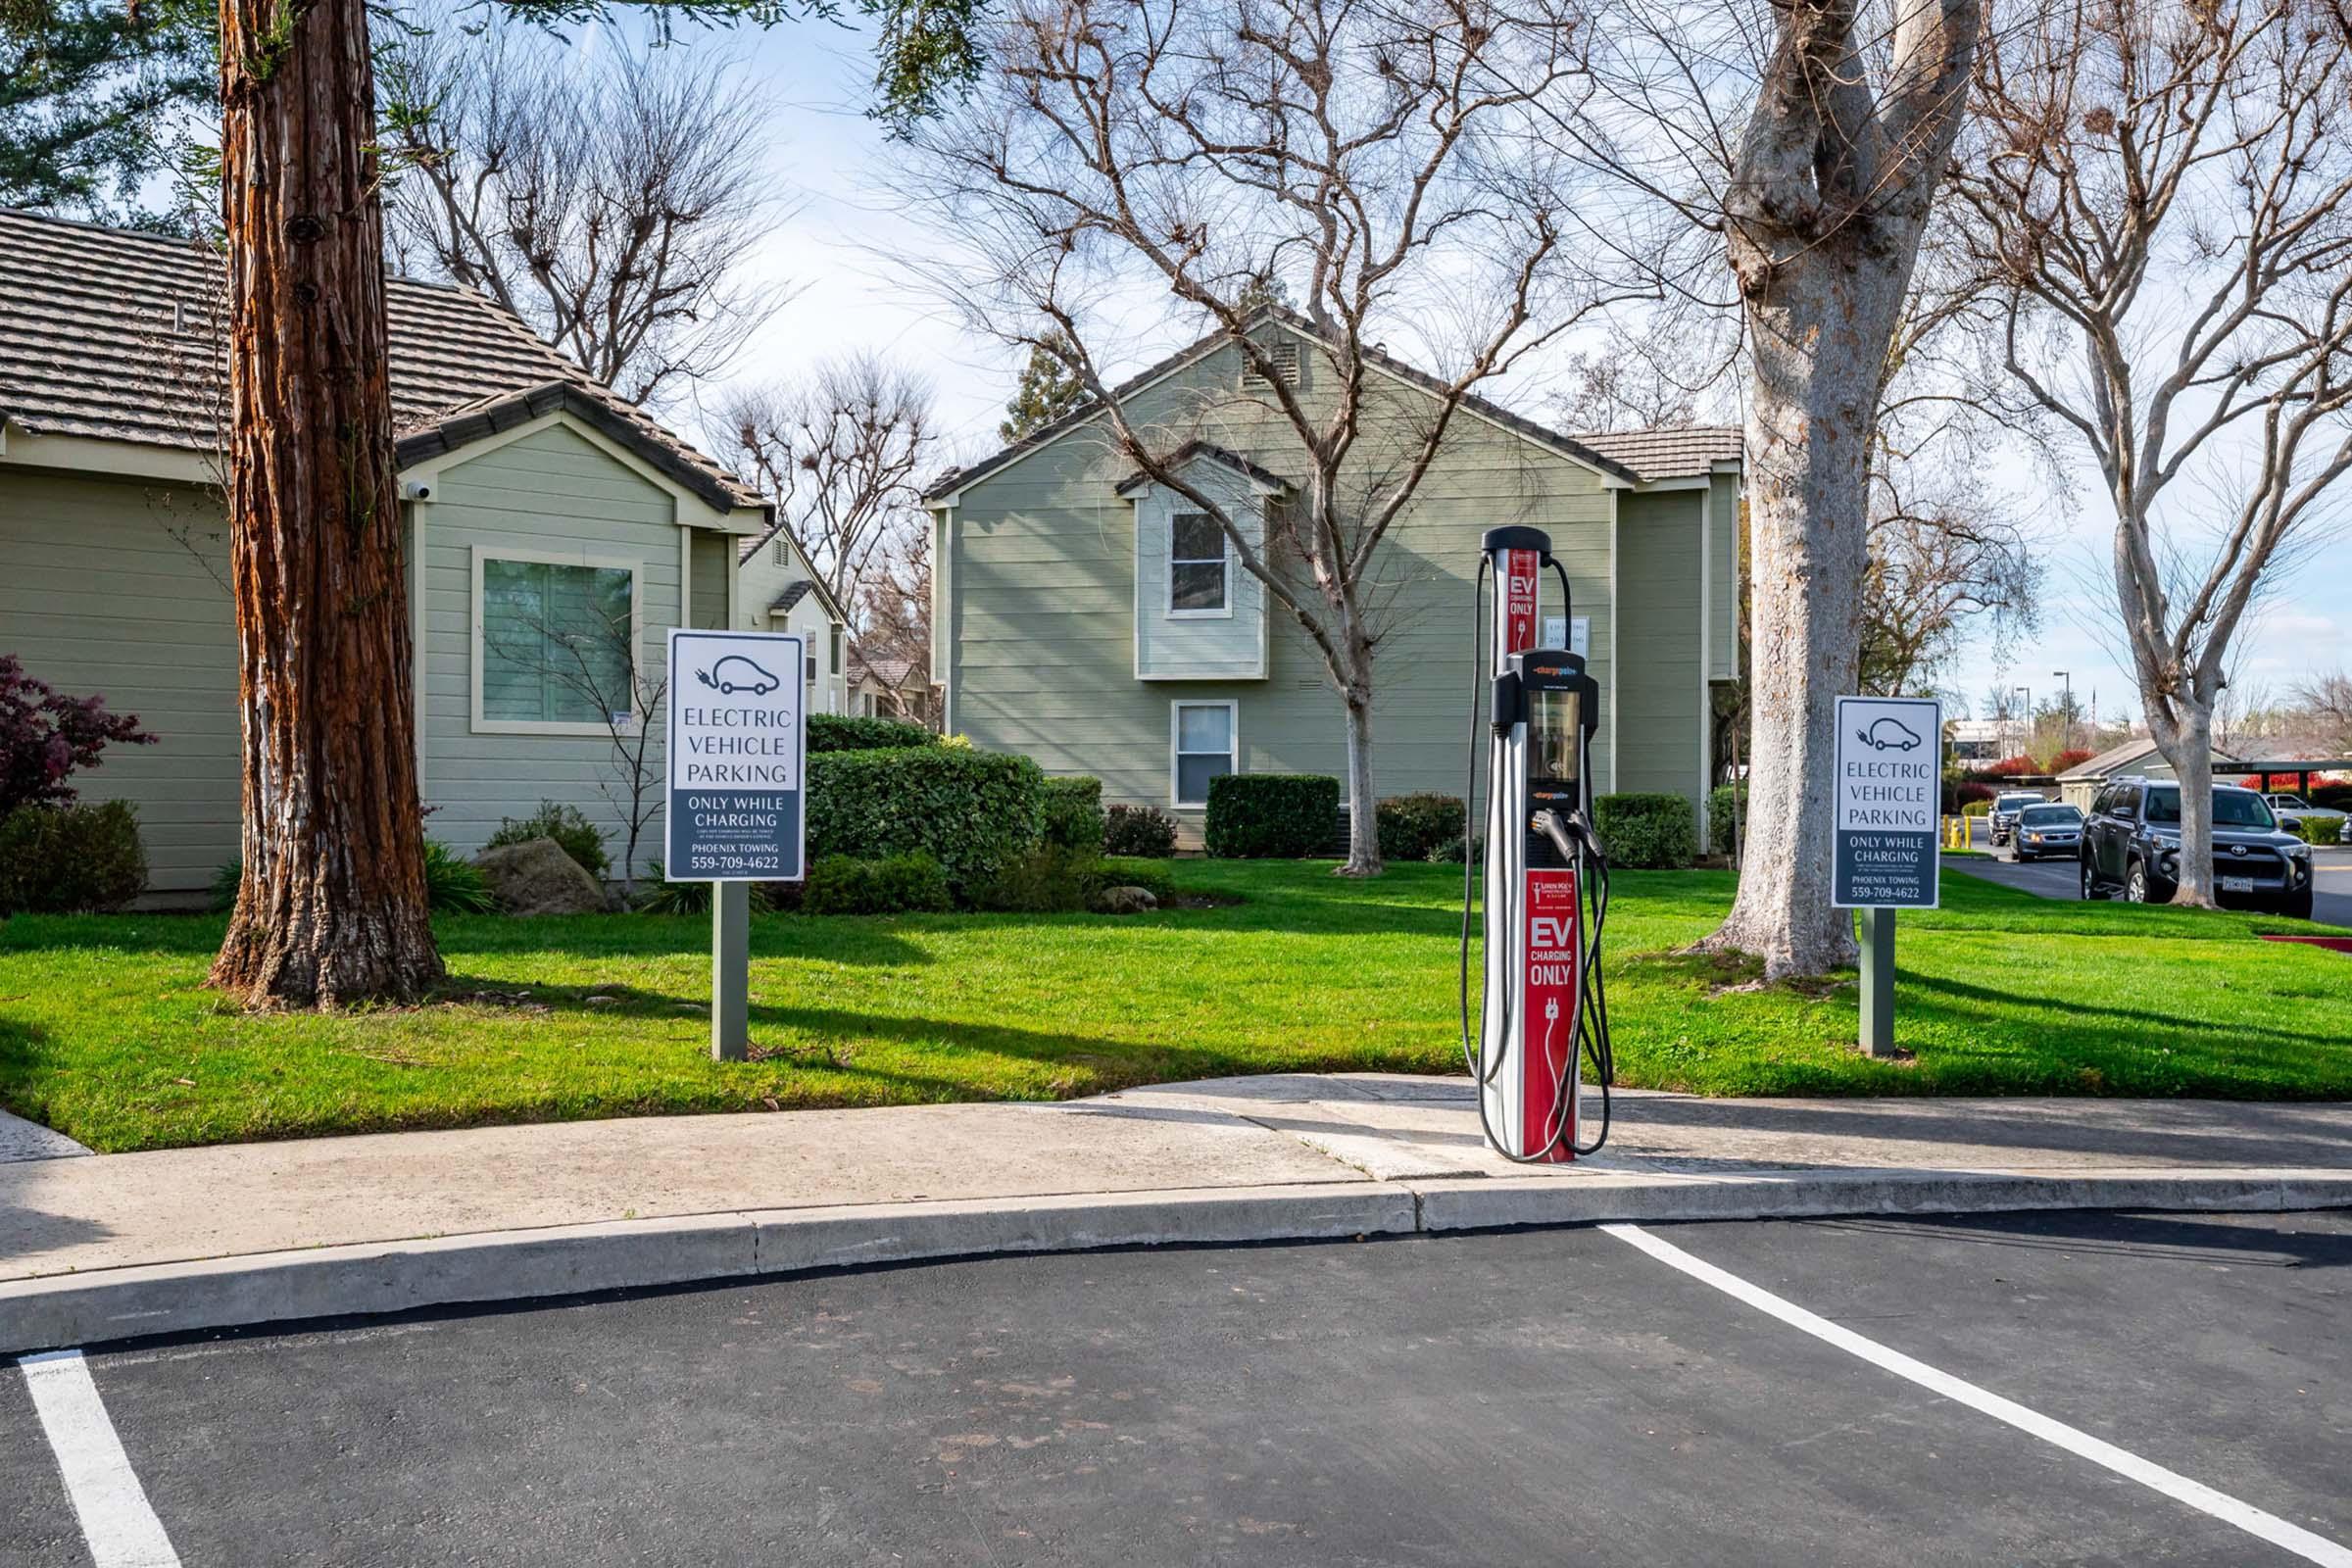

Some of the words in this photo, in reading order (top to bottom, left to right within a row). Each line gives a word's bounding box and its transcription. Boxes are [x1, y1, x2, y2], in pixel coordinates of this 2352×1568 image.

[1511, 576, 1535, 594] EV
[1510, 603, 1533, 614] ONLY
[685, 708, 792, 728] ELECTRIC
[688, 736, 785, 756] VEHICLE
[687, 764, 786, 783] PARKING
[1847, 761, 1931, 779] ELECTRIC
[1850, 785, 1926, 803] VEHICLE
[688, 797, 729, 809] ONLY
[734, 797, 784, 810] WHILE
[695, 814, 777, 827] CHARGING
[1849, 809, 1926, 825] PARKING
[691, 844, 736, 854] PHOENIX
[739, 844, 779, 854] TOWING
[1849, 836, 1882, 848] ONLY
[1885, 836, 1924, 849] WHILE
[1854, 850, 1919, 862] CHARGING
[691, 857, 779, 869] 559-709-4622
[1851, 875, 1887, 885] PHOENIX
[1888, 876, 1920, 885] TOWING
[1851, 886, 1920, 899] 559-709-4622
[1531, 917, 1573, 947] EV
[1531, 951, 1572, 961] CHARGING
[1531, 964, 1571, 986] ONLY
